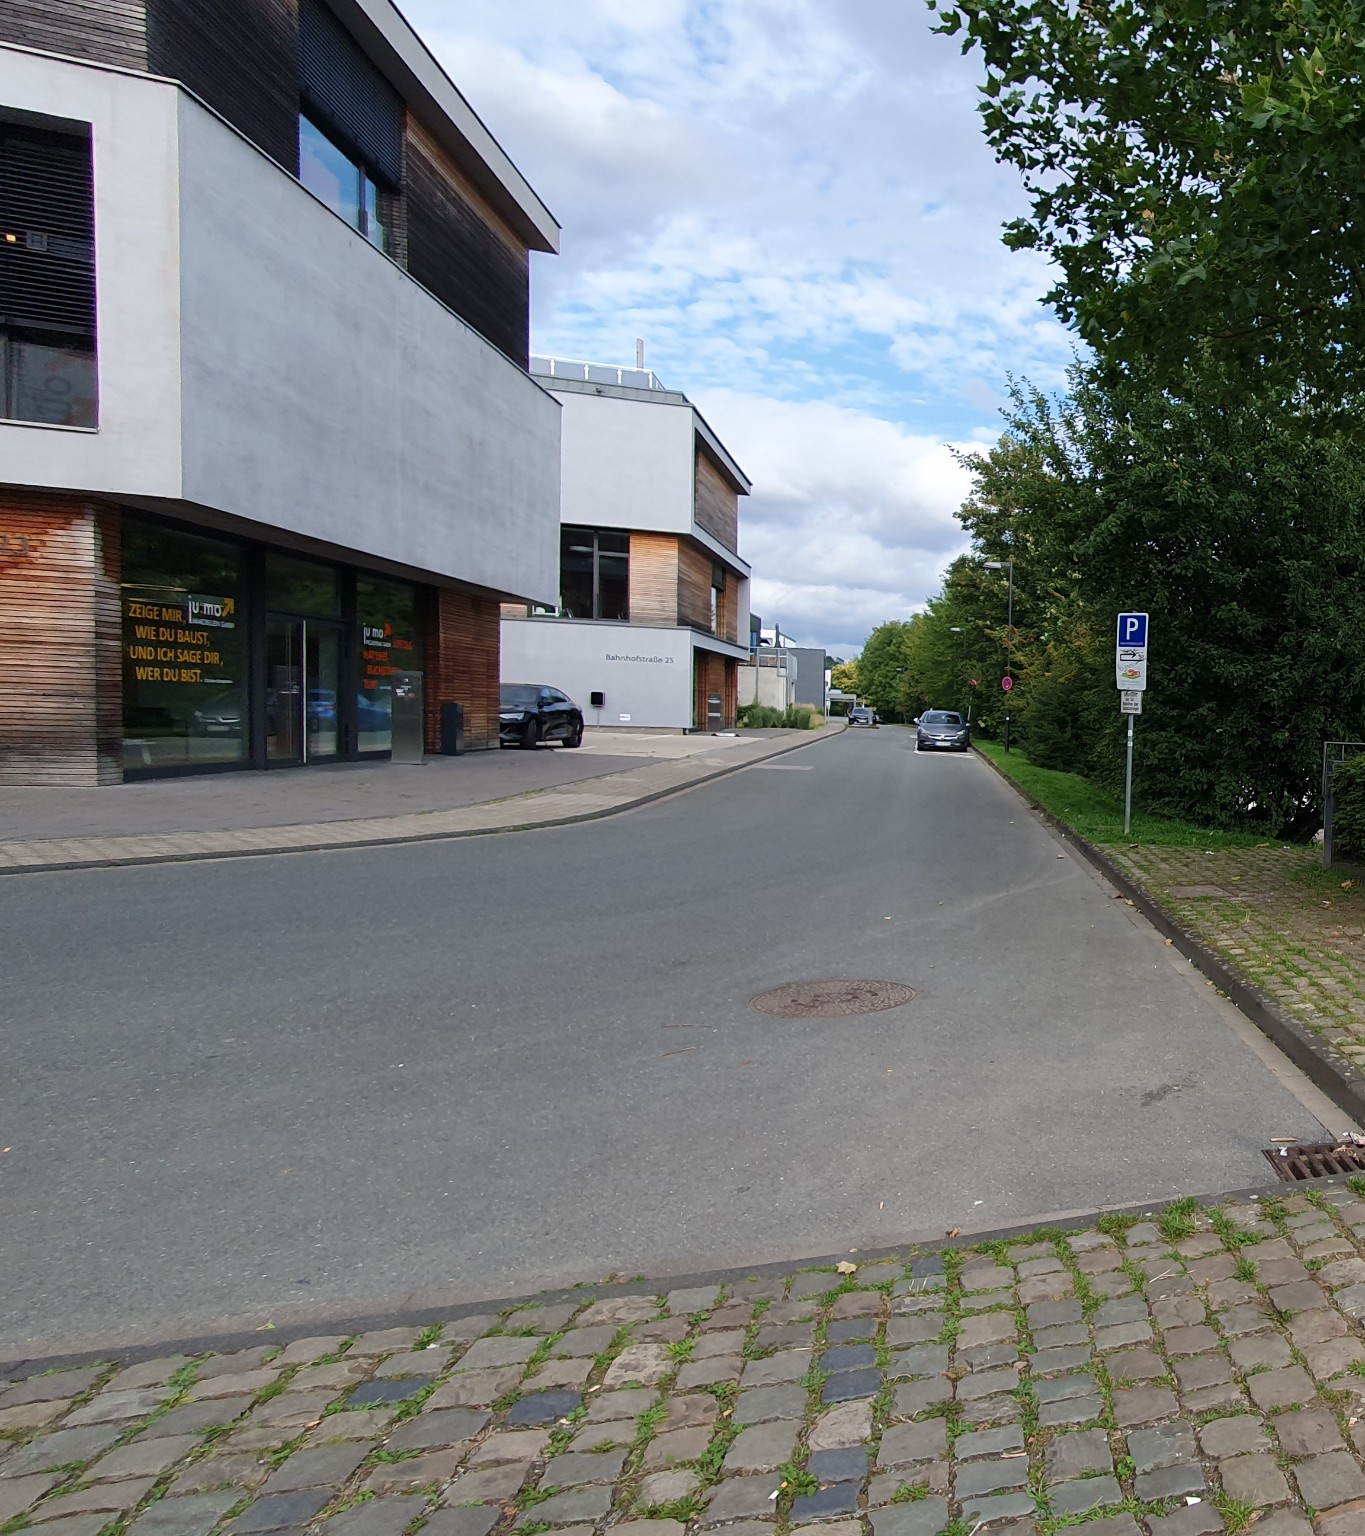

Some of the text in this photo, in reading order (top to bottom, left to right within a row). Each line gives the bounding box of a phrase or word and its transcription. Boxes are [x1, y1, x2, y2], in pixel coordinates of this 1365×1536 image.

[129, 604, 159, 619] ZEIGE
[162, 608, 186, 625] MIR,
[135, 625, 210, 647] WIE DU BAUST,
[1126, 618, 1139, 640] P
[130, 646, 224, 667] UND ICH SAGE DIR,
[606, 654, 662, 663] Bahnhofstraße
[136, 667, 161, 680] WER
[163, 669, 179, 681] DU
[181, 669, 204, 683] BIST.
